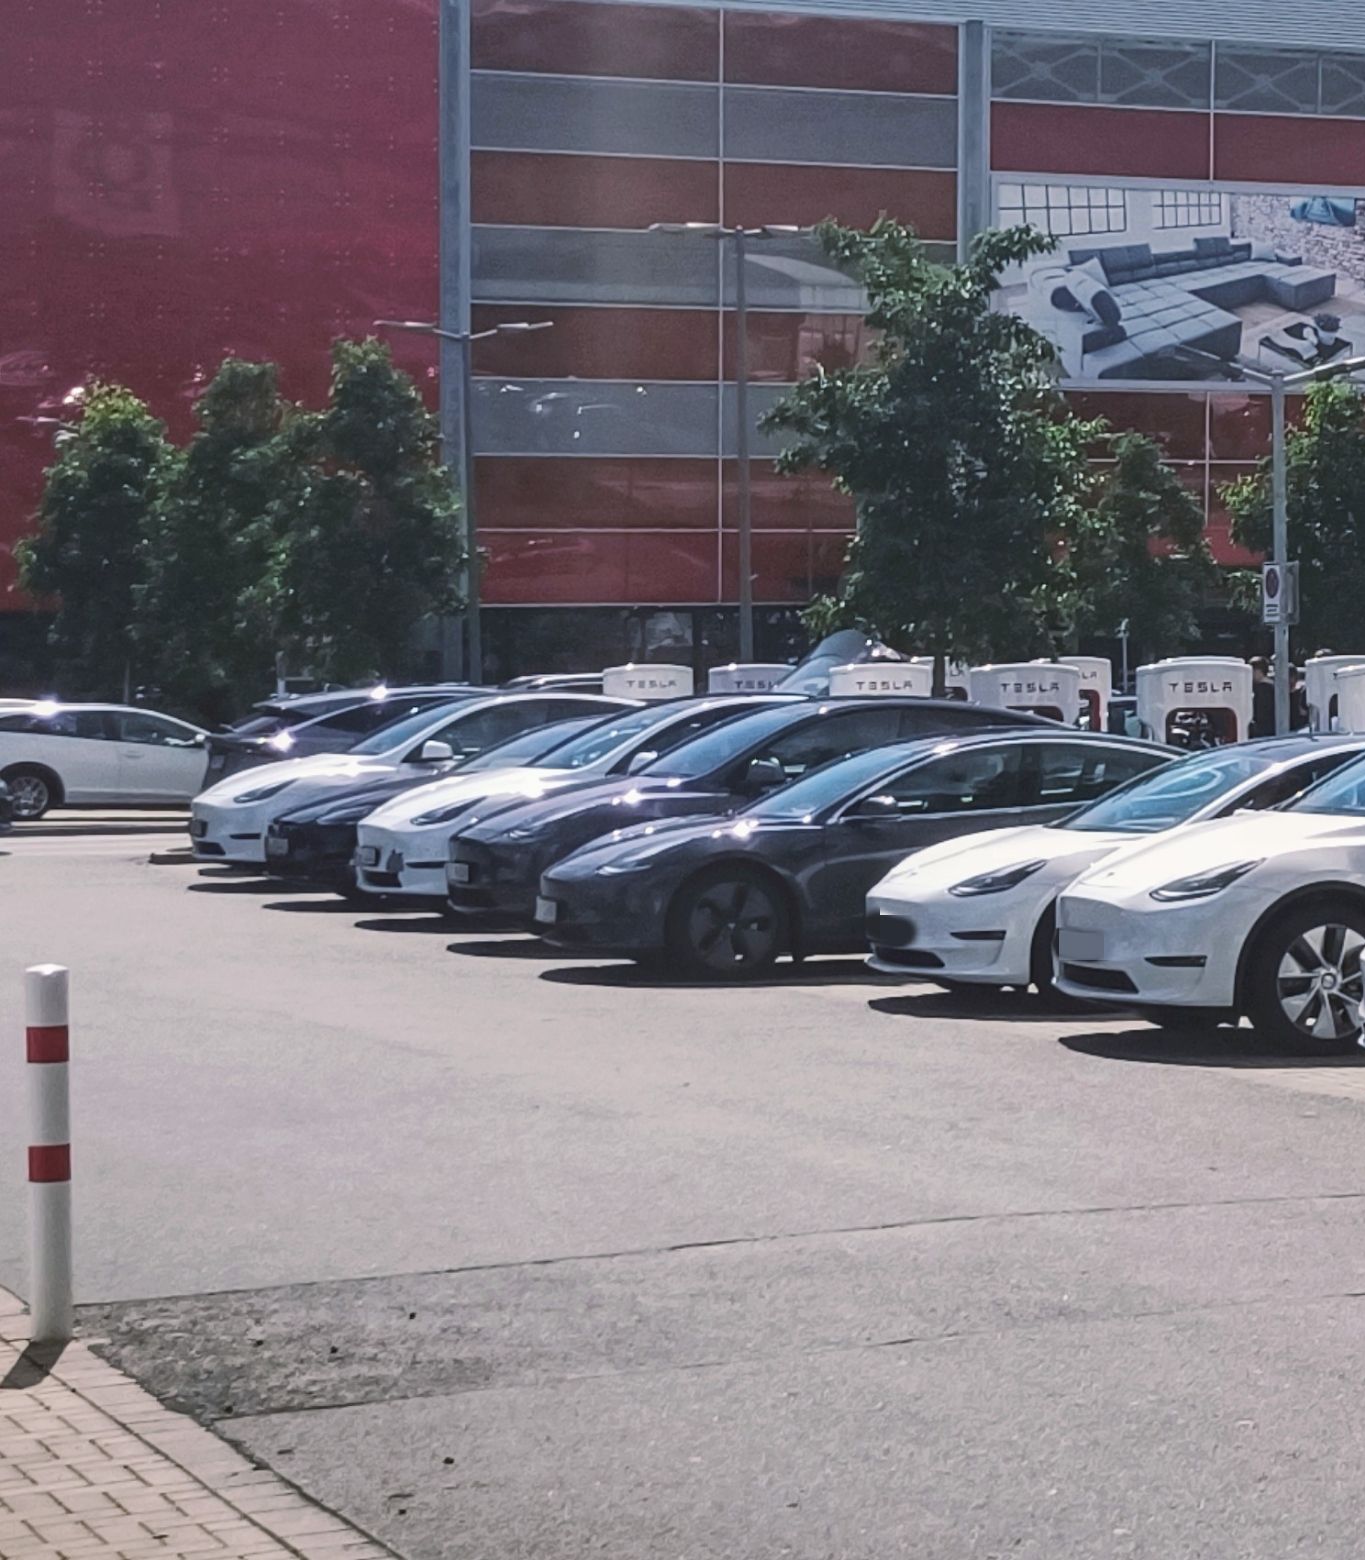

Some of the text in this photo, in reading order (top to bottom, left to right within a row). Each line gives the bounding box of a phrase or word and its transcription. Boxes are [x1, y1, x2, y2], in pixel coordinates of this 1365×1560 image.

[626, 680, 677, 689] TESLA
[734, 681, 774, 690] TESL
[856, 681, 912, 691] TESLA
[1000, 682, 1060, 693] TESLA
[1168, 681, 1233, 693] TESLA
